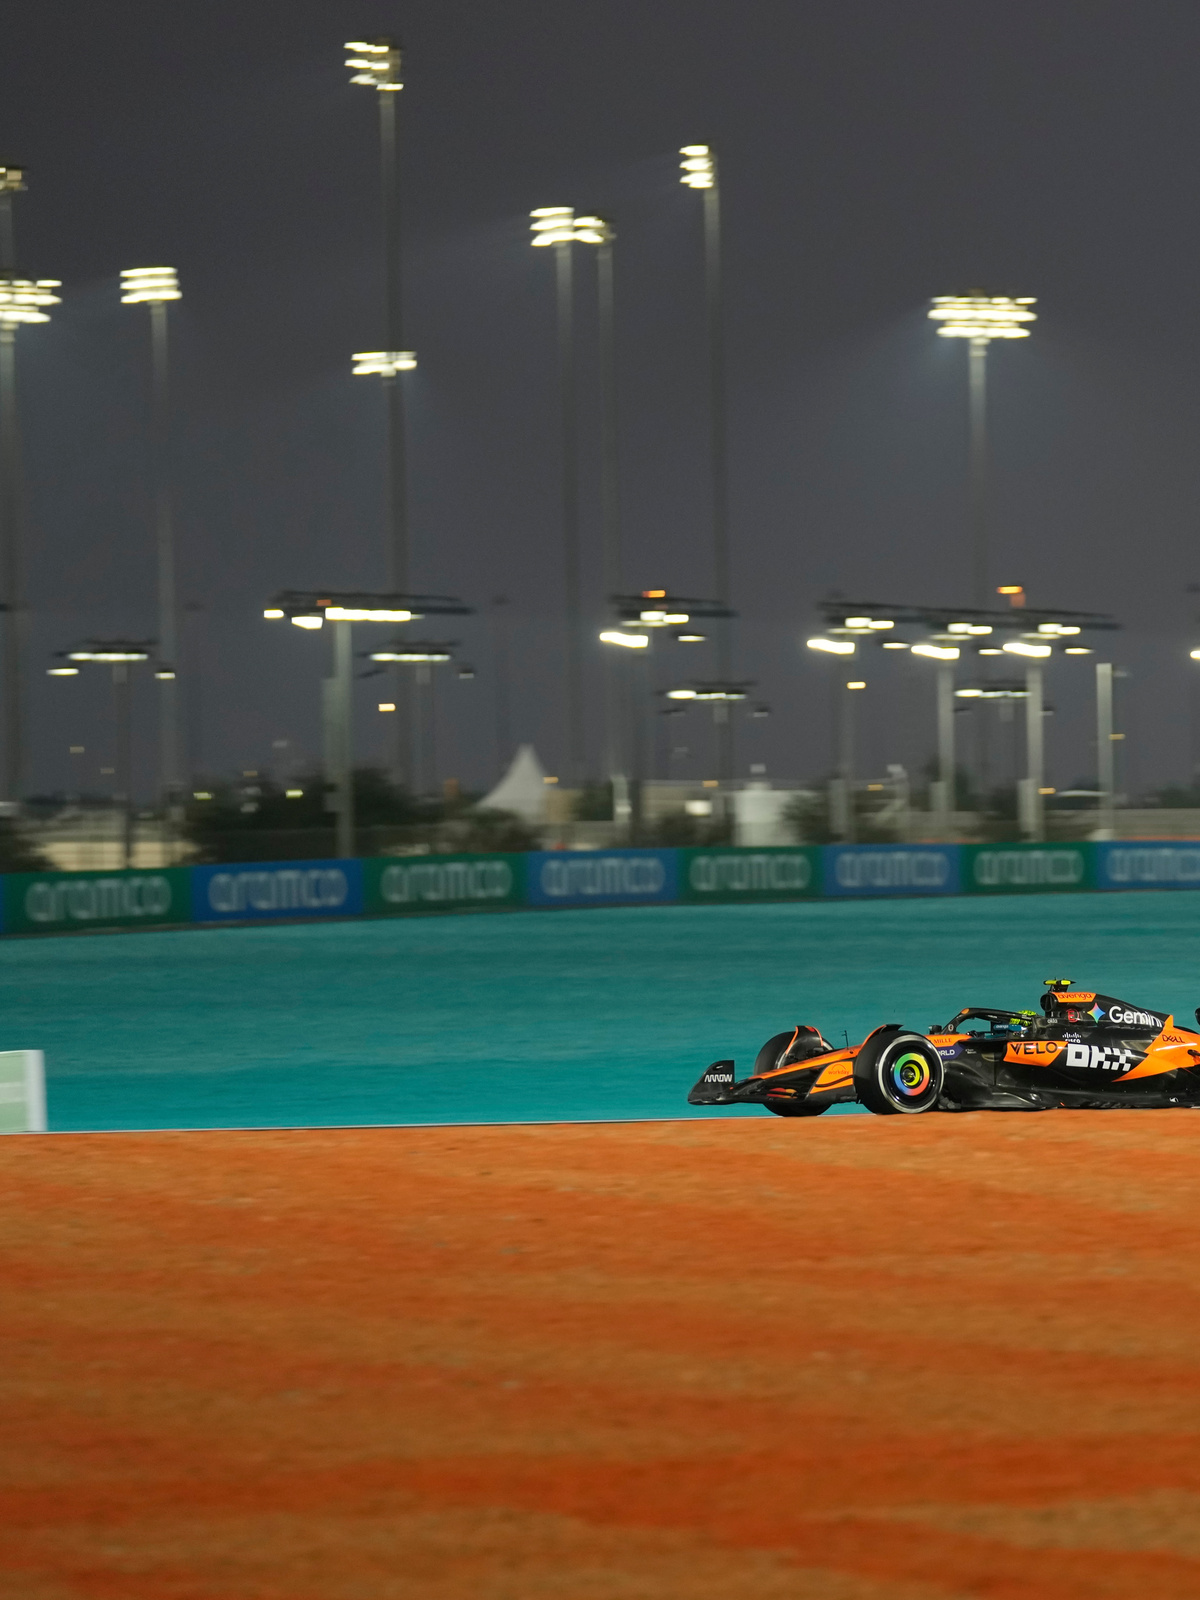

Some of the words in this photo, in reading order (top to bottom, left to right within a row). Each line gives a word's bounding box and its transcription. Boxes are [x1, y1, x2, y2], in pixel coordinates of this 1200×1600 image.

[208, 869, 349, 912] aramco
[381, 861, 513, 903] aramco
[541, 857, 666, 896] aramco
[25, 876, 172, 922] aramco
[1011, 1042, 1058, 1055] VELO
[1162, 1034, 1185, 1043] DELL
[704, 1074, 733, 1083] ARROW
